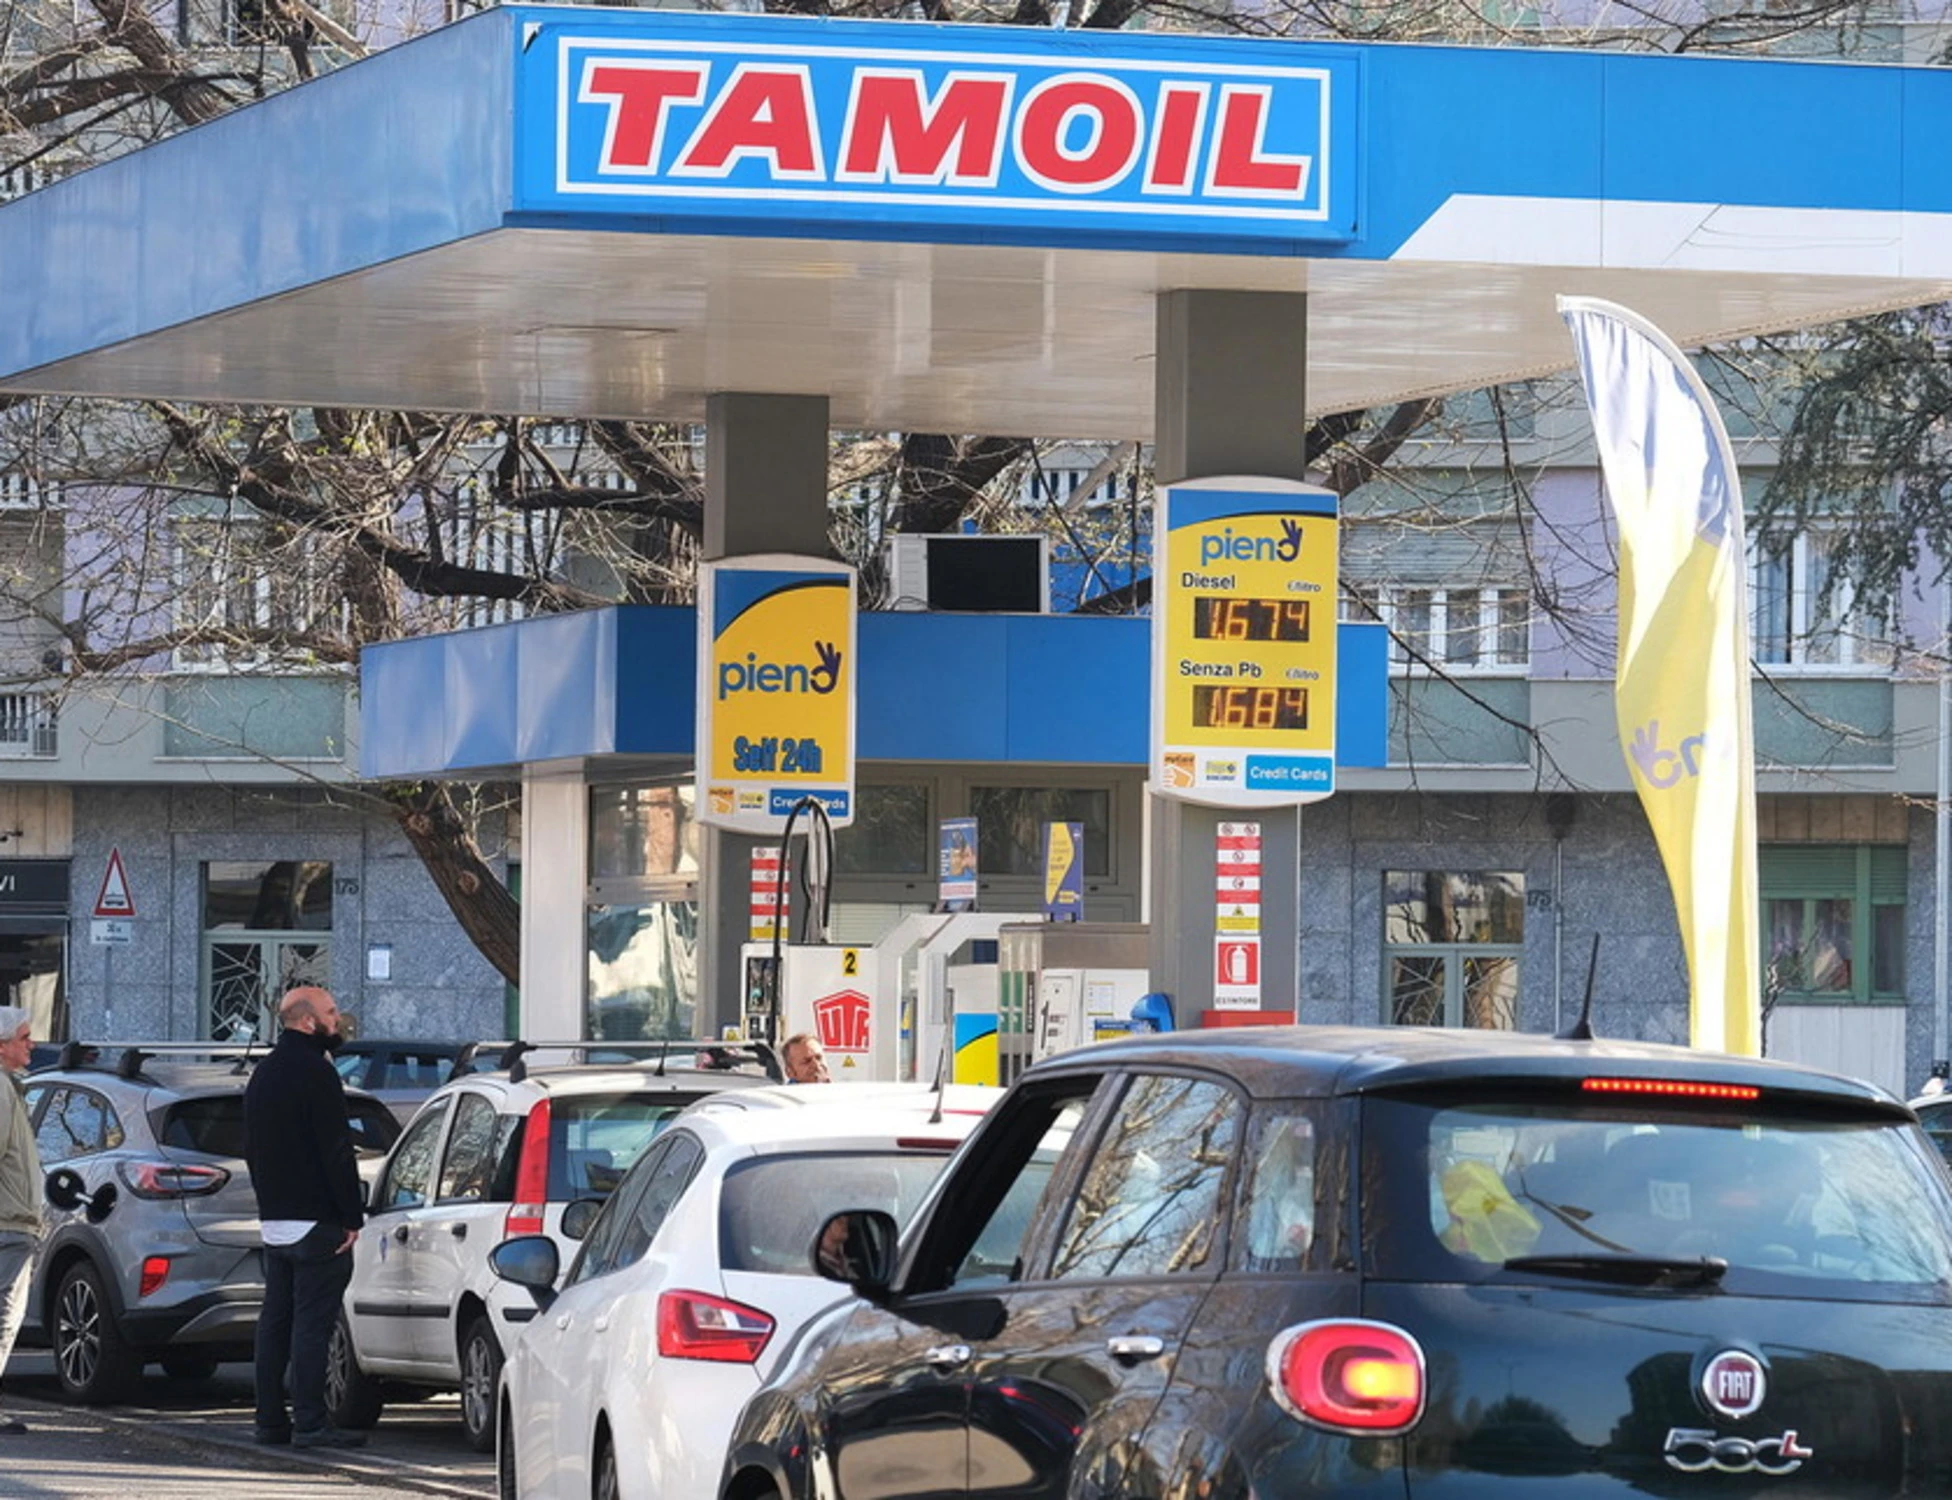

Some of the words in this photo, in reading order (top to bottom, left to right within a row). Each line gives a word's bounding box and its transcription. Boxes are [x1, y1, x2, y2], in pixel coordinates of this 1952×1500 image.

[578, 58, 1312, 201] TAMOIL
[1201, 518, 1303, 566] pieno
[1182, 572, 1235, 589] Diesel
[719, 640, 842, 701] pieno
[1180, 660, 1233, 677] Senza
[1239, 662, 1262, 679] Pb
[733, 736, 778, 773] Self
[781, 738, 822, 774] 24h
[1250, 766, 1288, 780] Credit
[1290, 767, 1328, 782] Cards
[845, 952, 856, 974] 2
[1718, 1371, 1752, 1400] FIAT
[1664, 1428, 1814, 1475] 500L
